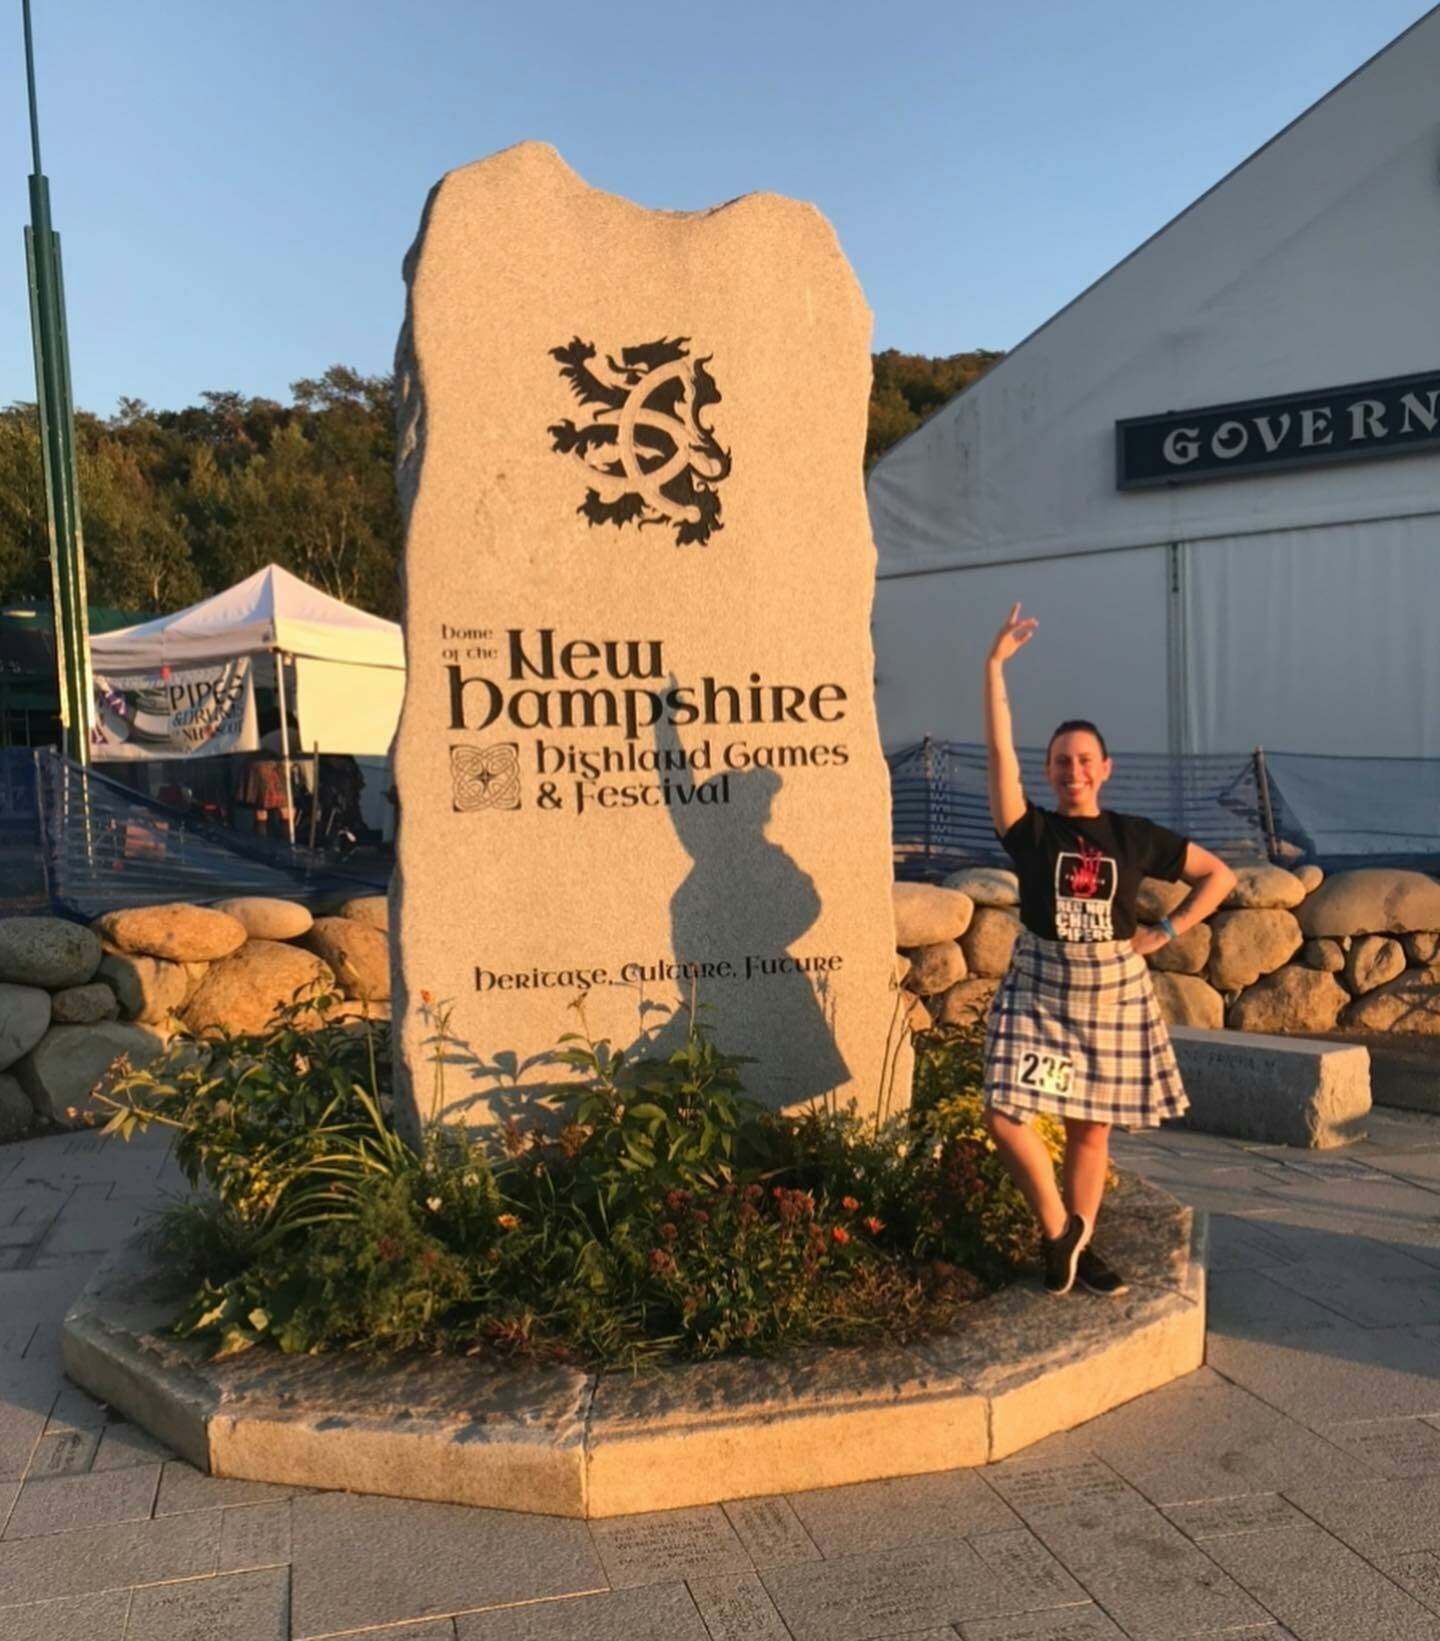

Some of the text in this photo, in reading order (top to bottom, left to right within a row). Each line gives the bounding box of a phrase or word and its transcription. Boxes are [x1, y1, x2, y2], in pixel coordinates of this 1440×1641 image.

[1162, 390, 1440, 465] GOVERN
[466, 646, 499, 660] the
[507, 629, 664, 681] New
[723, 740, 849, 770] Games
[536, 774, 730, 815] & Festival
[745, 954, 843, 980] Future
